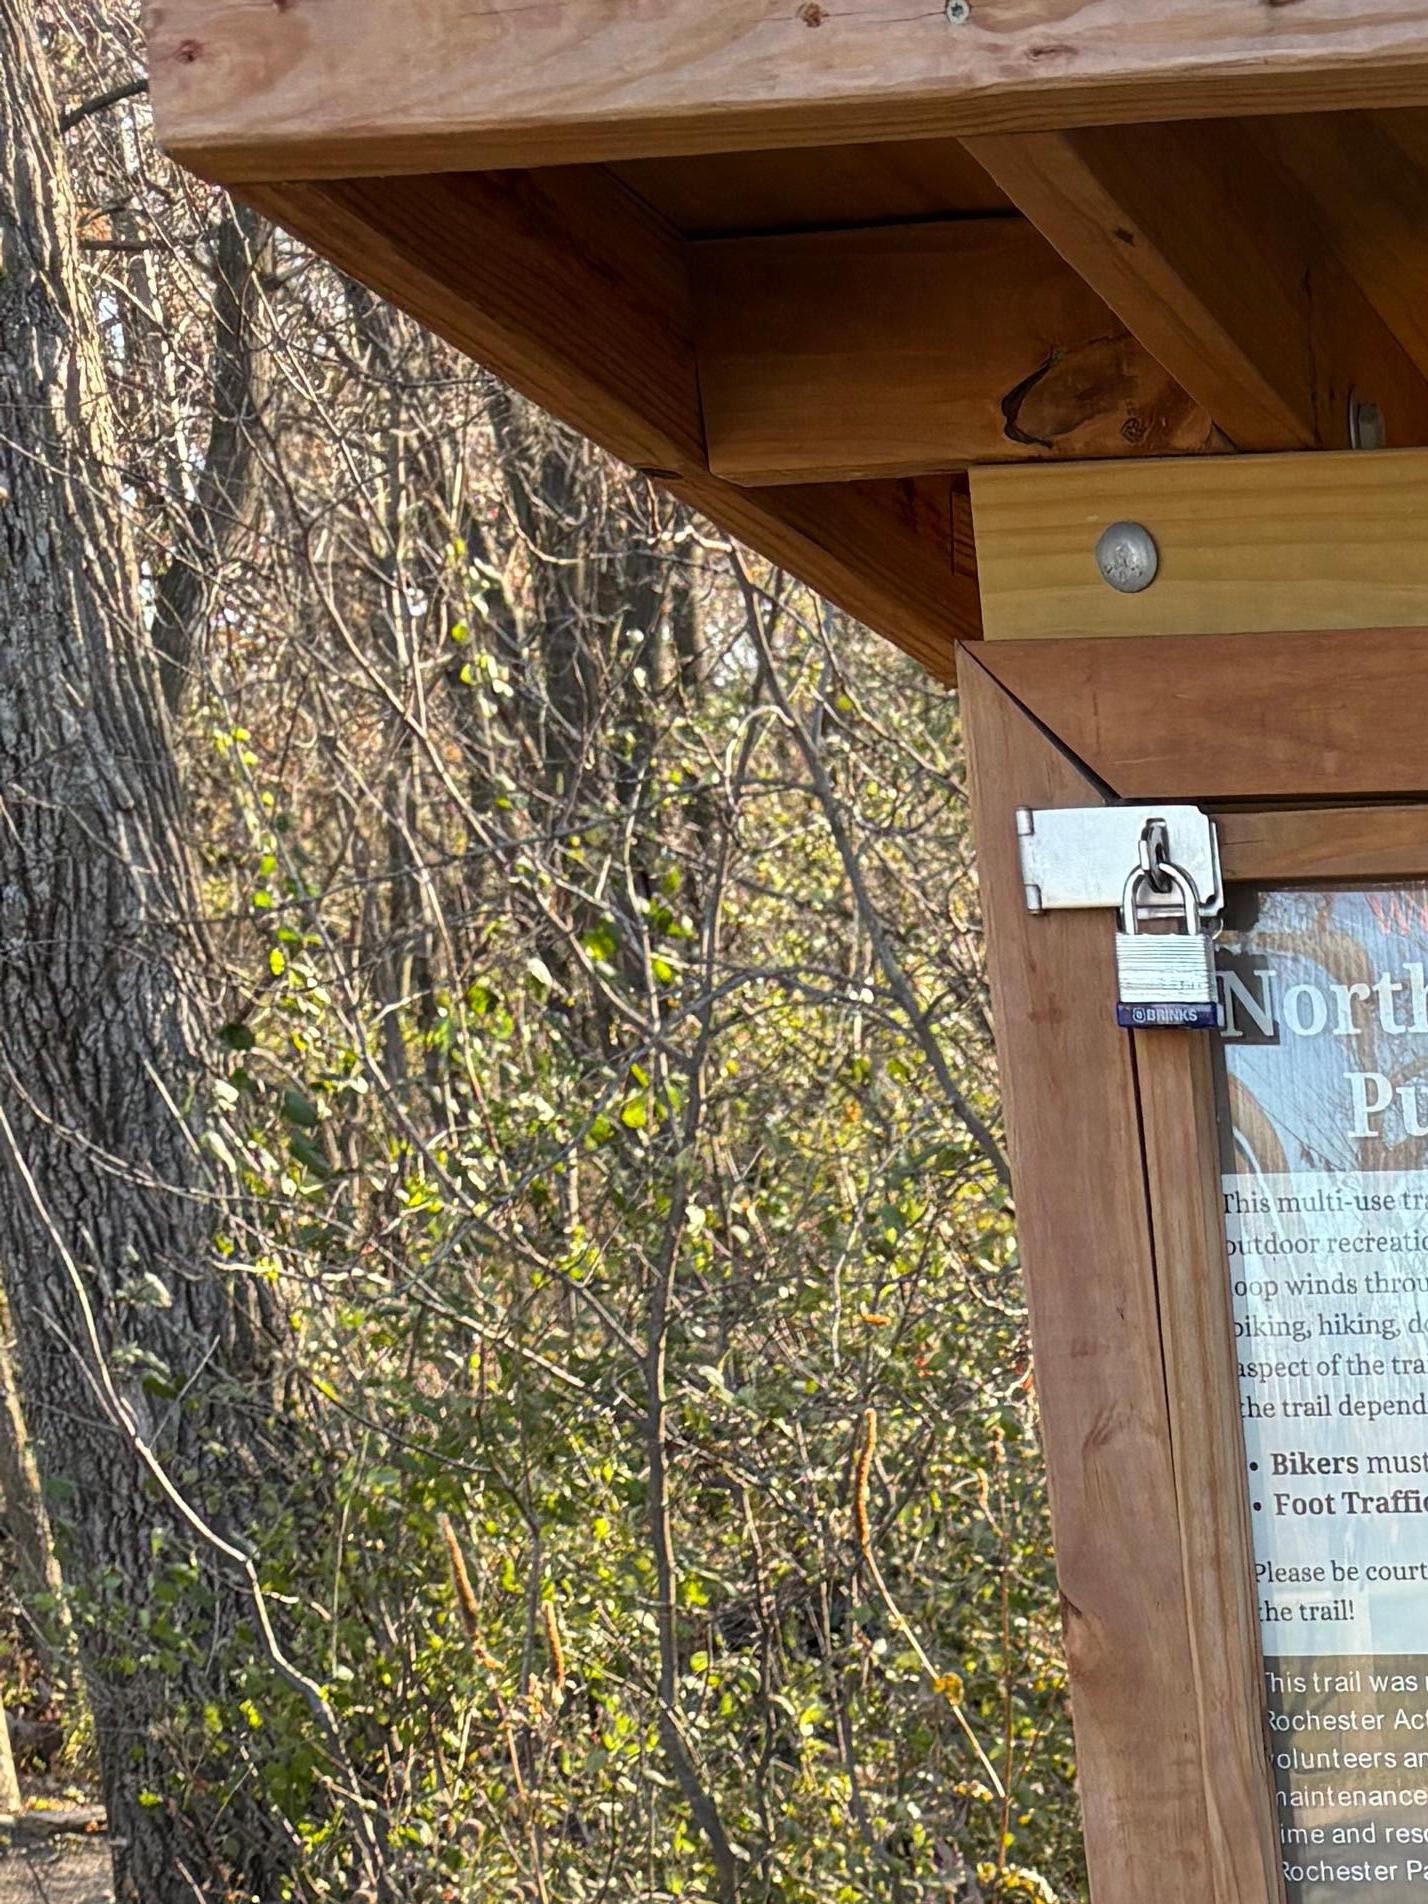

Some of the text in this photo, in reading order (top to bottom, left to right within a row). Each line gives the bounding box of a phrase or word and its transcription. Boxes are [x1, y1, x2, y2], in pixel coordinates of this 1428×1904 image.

[1147, 1008, 1199, 1022] BRINKS
[1224, 1191, 1271, 1215] This
[1277, 1191, 1396, 1214] multi-use
[1226, 1232, 1321, 1256] outdoor
[1281, 1394, 1332, 1418] trail
[1269, 1451, 1360, 1476] Bikers
[1273, 1493, 1337, 1516] Foot
[1265, 1671, 1306, 1694] his
[1312, 1671, 1361, 1693] trail
[1368, 1675, 1419, 1692] was
